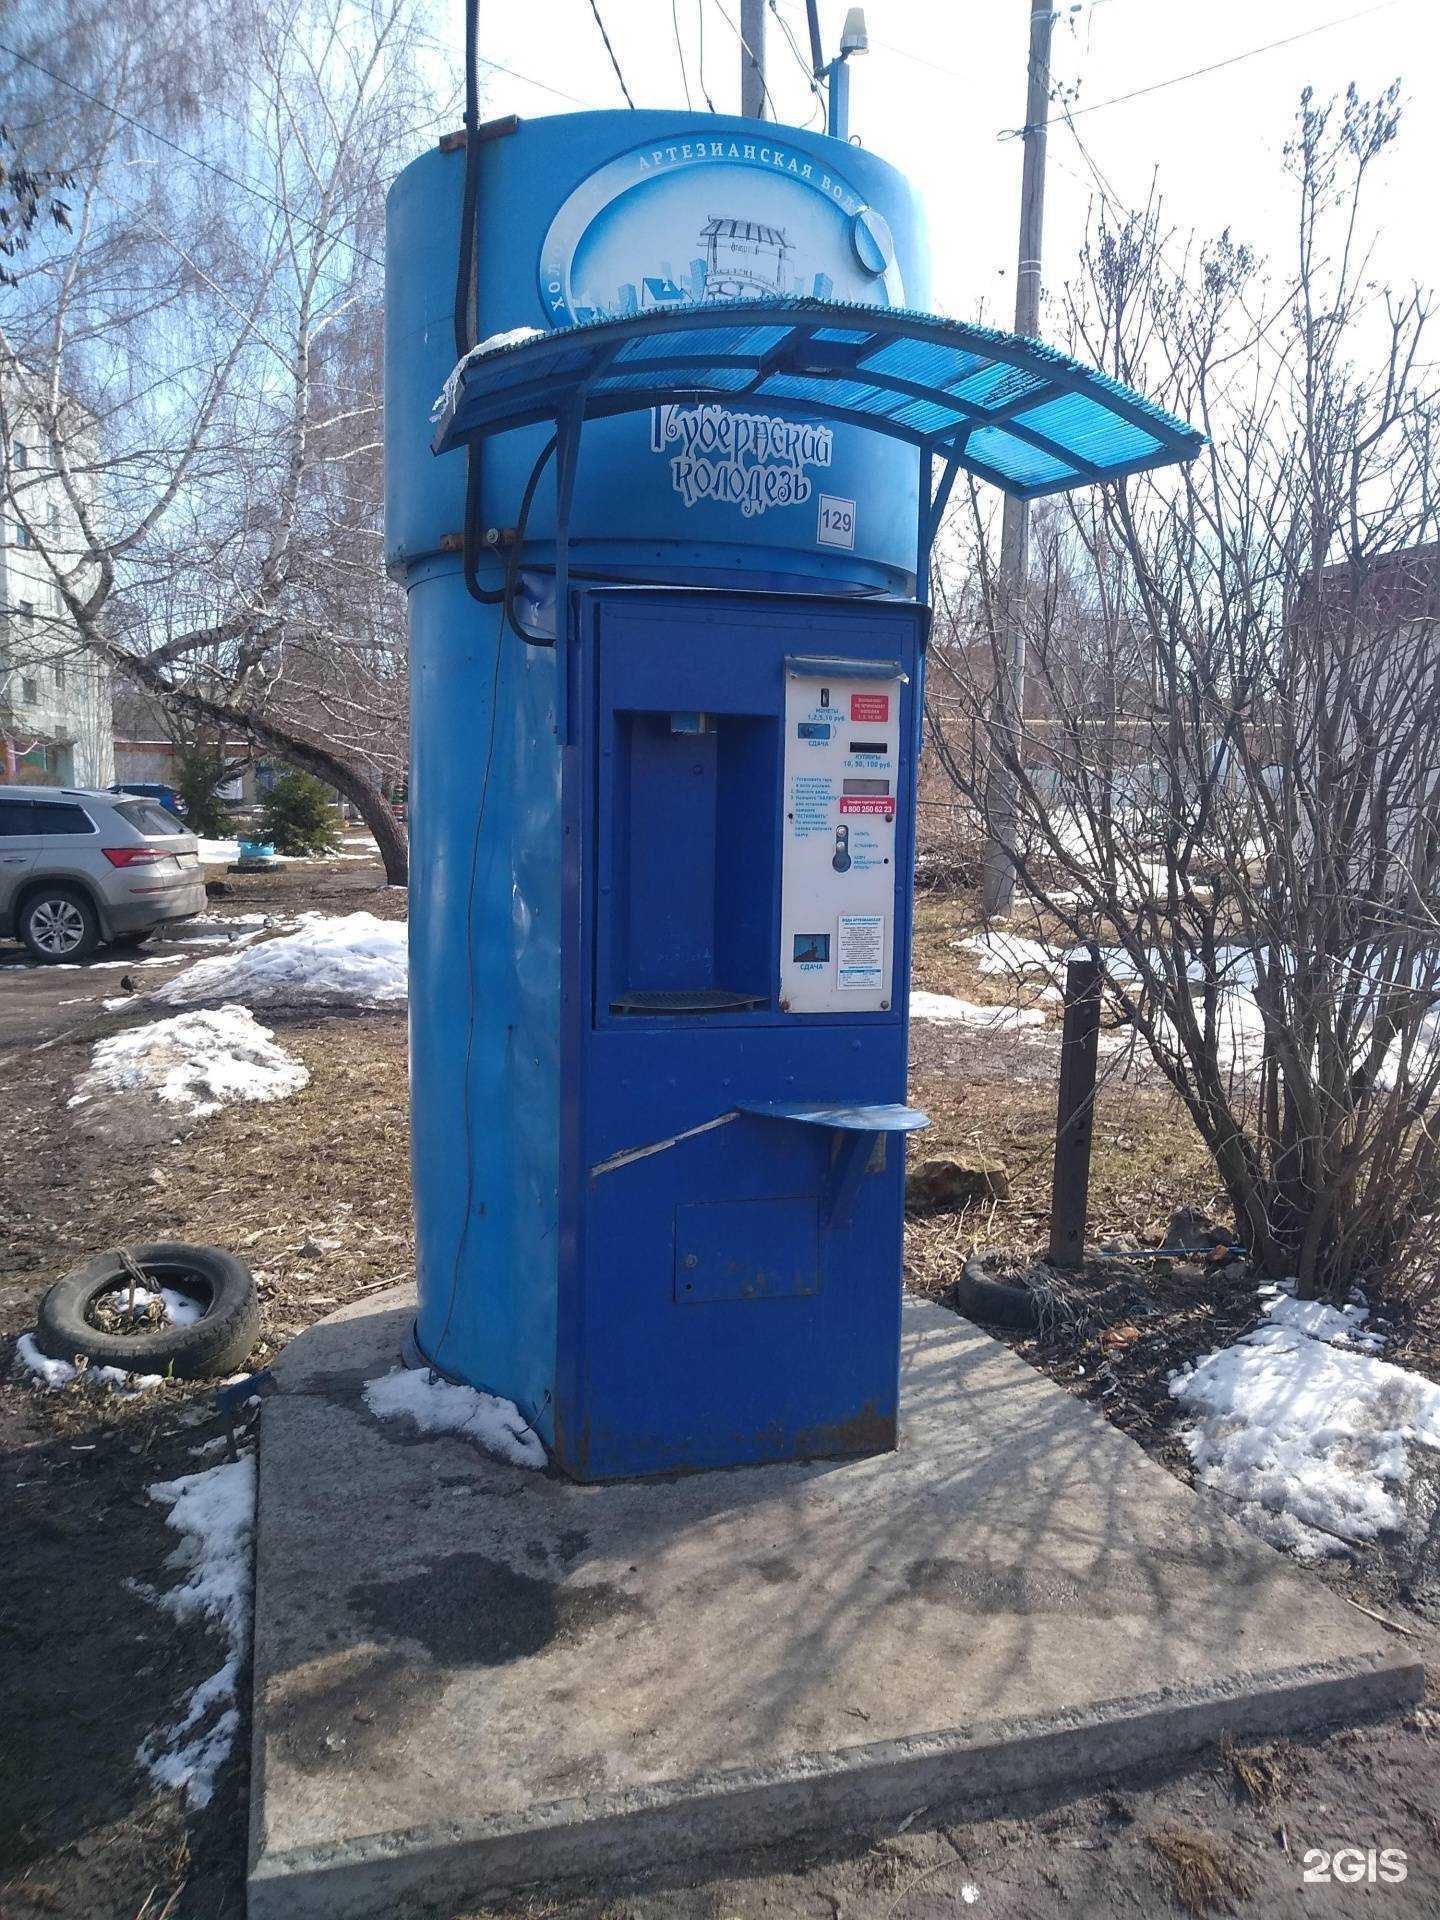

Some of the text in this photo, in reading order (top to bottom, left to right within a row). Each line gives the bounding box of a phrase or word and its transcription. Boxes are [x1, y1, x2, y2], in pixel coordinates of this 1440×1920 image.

[638, 142, 814, 180] АРТЕЗИАНСКАЯ
[822, 508, 852, 532] 129
[800, 963, 824, 971] СДАЧА
